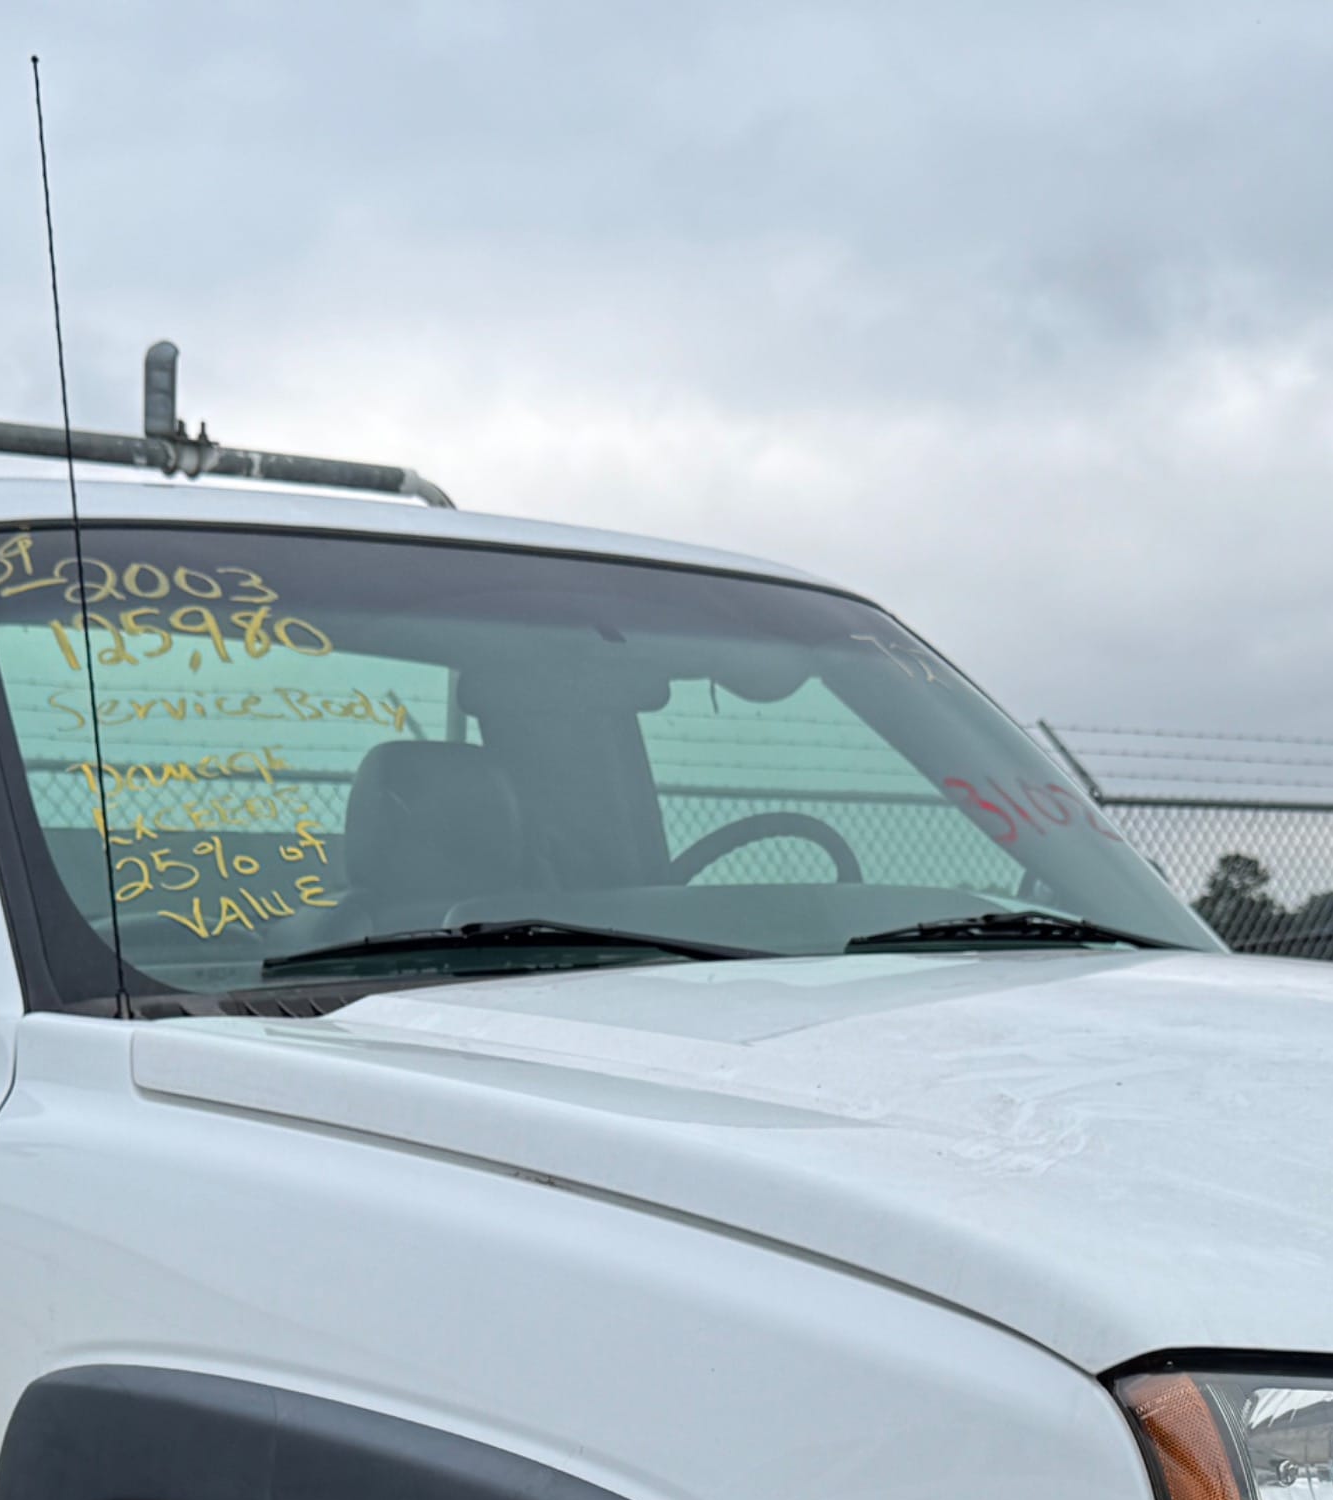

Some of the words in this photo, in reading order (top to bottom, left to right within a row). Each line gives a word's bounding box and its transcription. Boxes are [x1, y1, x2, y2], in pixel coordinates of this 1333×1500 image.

[53, 557, 279, 603] 2003
[49, 605, 333, 672] 125,980
[271, 687, 407, 732] Body
[117, 836, 260, 903] 25%
[279, 820, 328, 865] of
